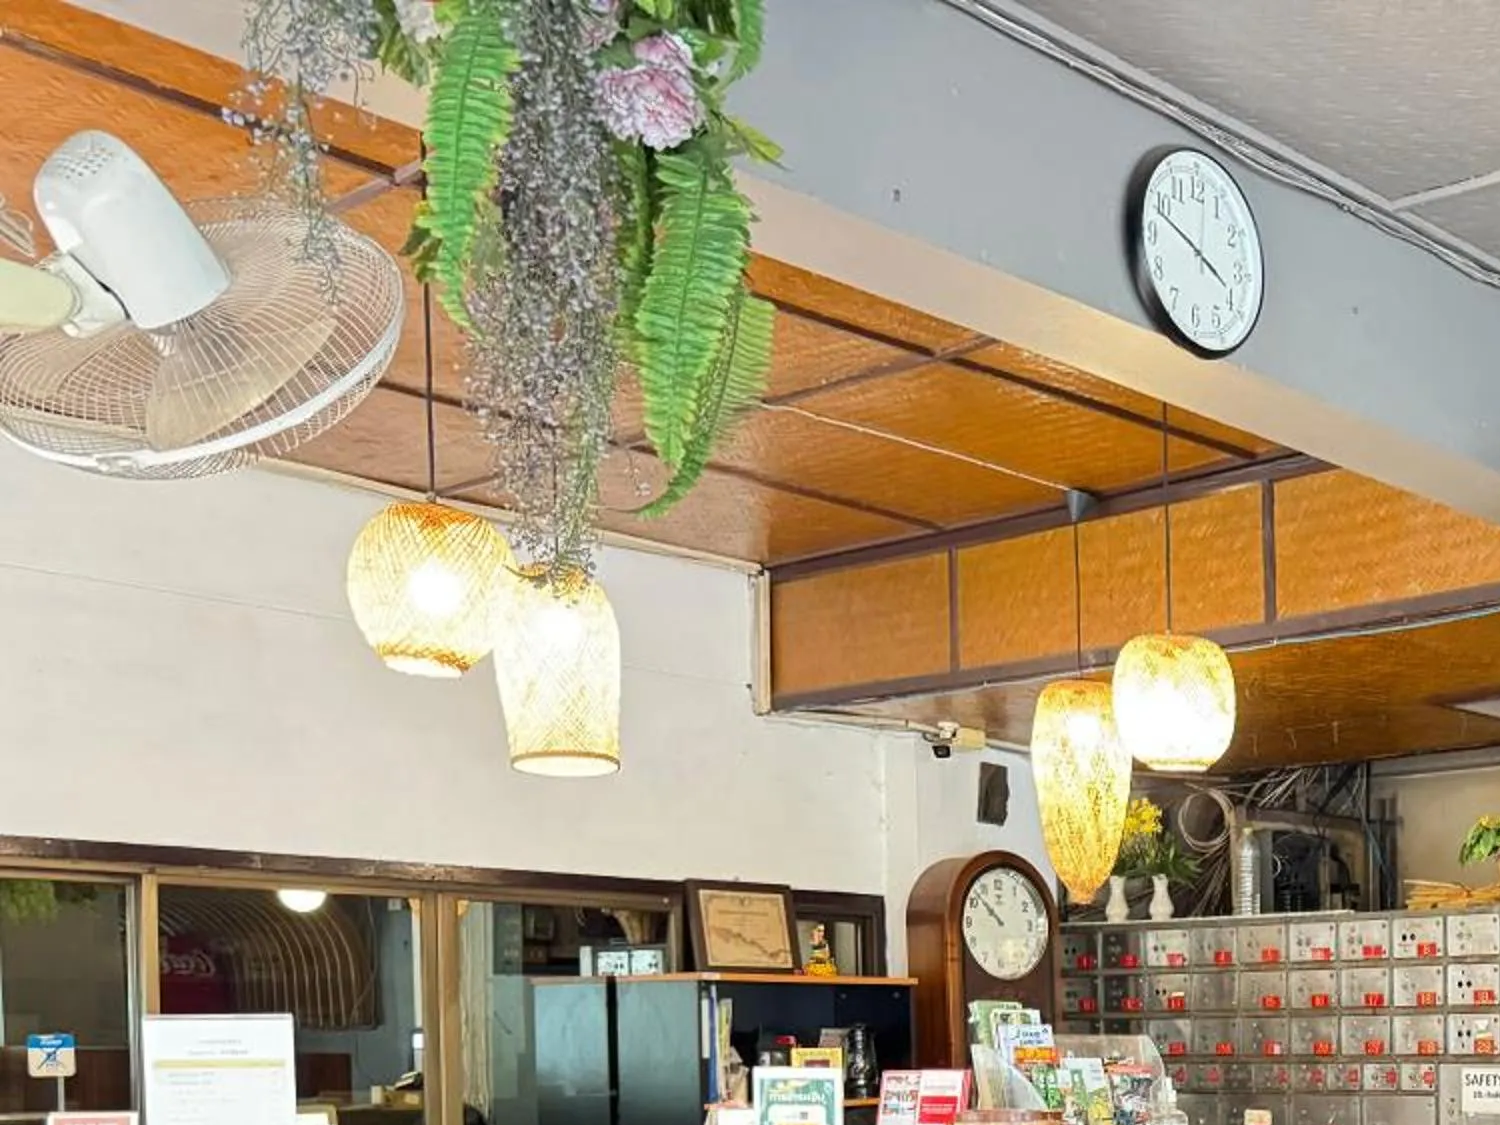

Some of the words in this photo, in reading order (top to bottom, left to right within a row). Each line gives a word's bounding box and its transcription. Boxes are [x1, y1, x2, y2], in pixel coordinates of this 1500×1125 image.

[1171, 175, 1185, 205] 11
[1190, 175, 1205, 204] 12
[1156, 191, 1171, 217] 10
[1213, 195, 1220, 219] 1
[1147, 221, 1157, 246] 9
[1227, 224, 1236, 248] 2
[1153, 255, 1164, 281] 8
[1233, 260, 1243, 284] 3
[1169, 286, 1180, 311] 7
[1226, 287, 1234, 312] 4
[1191, 304, 1201, 328] 6
[1211, 305, 1221, 328] 5
